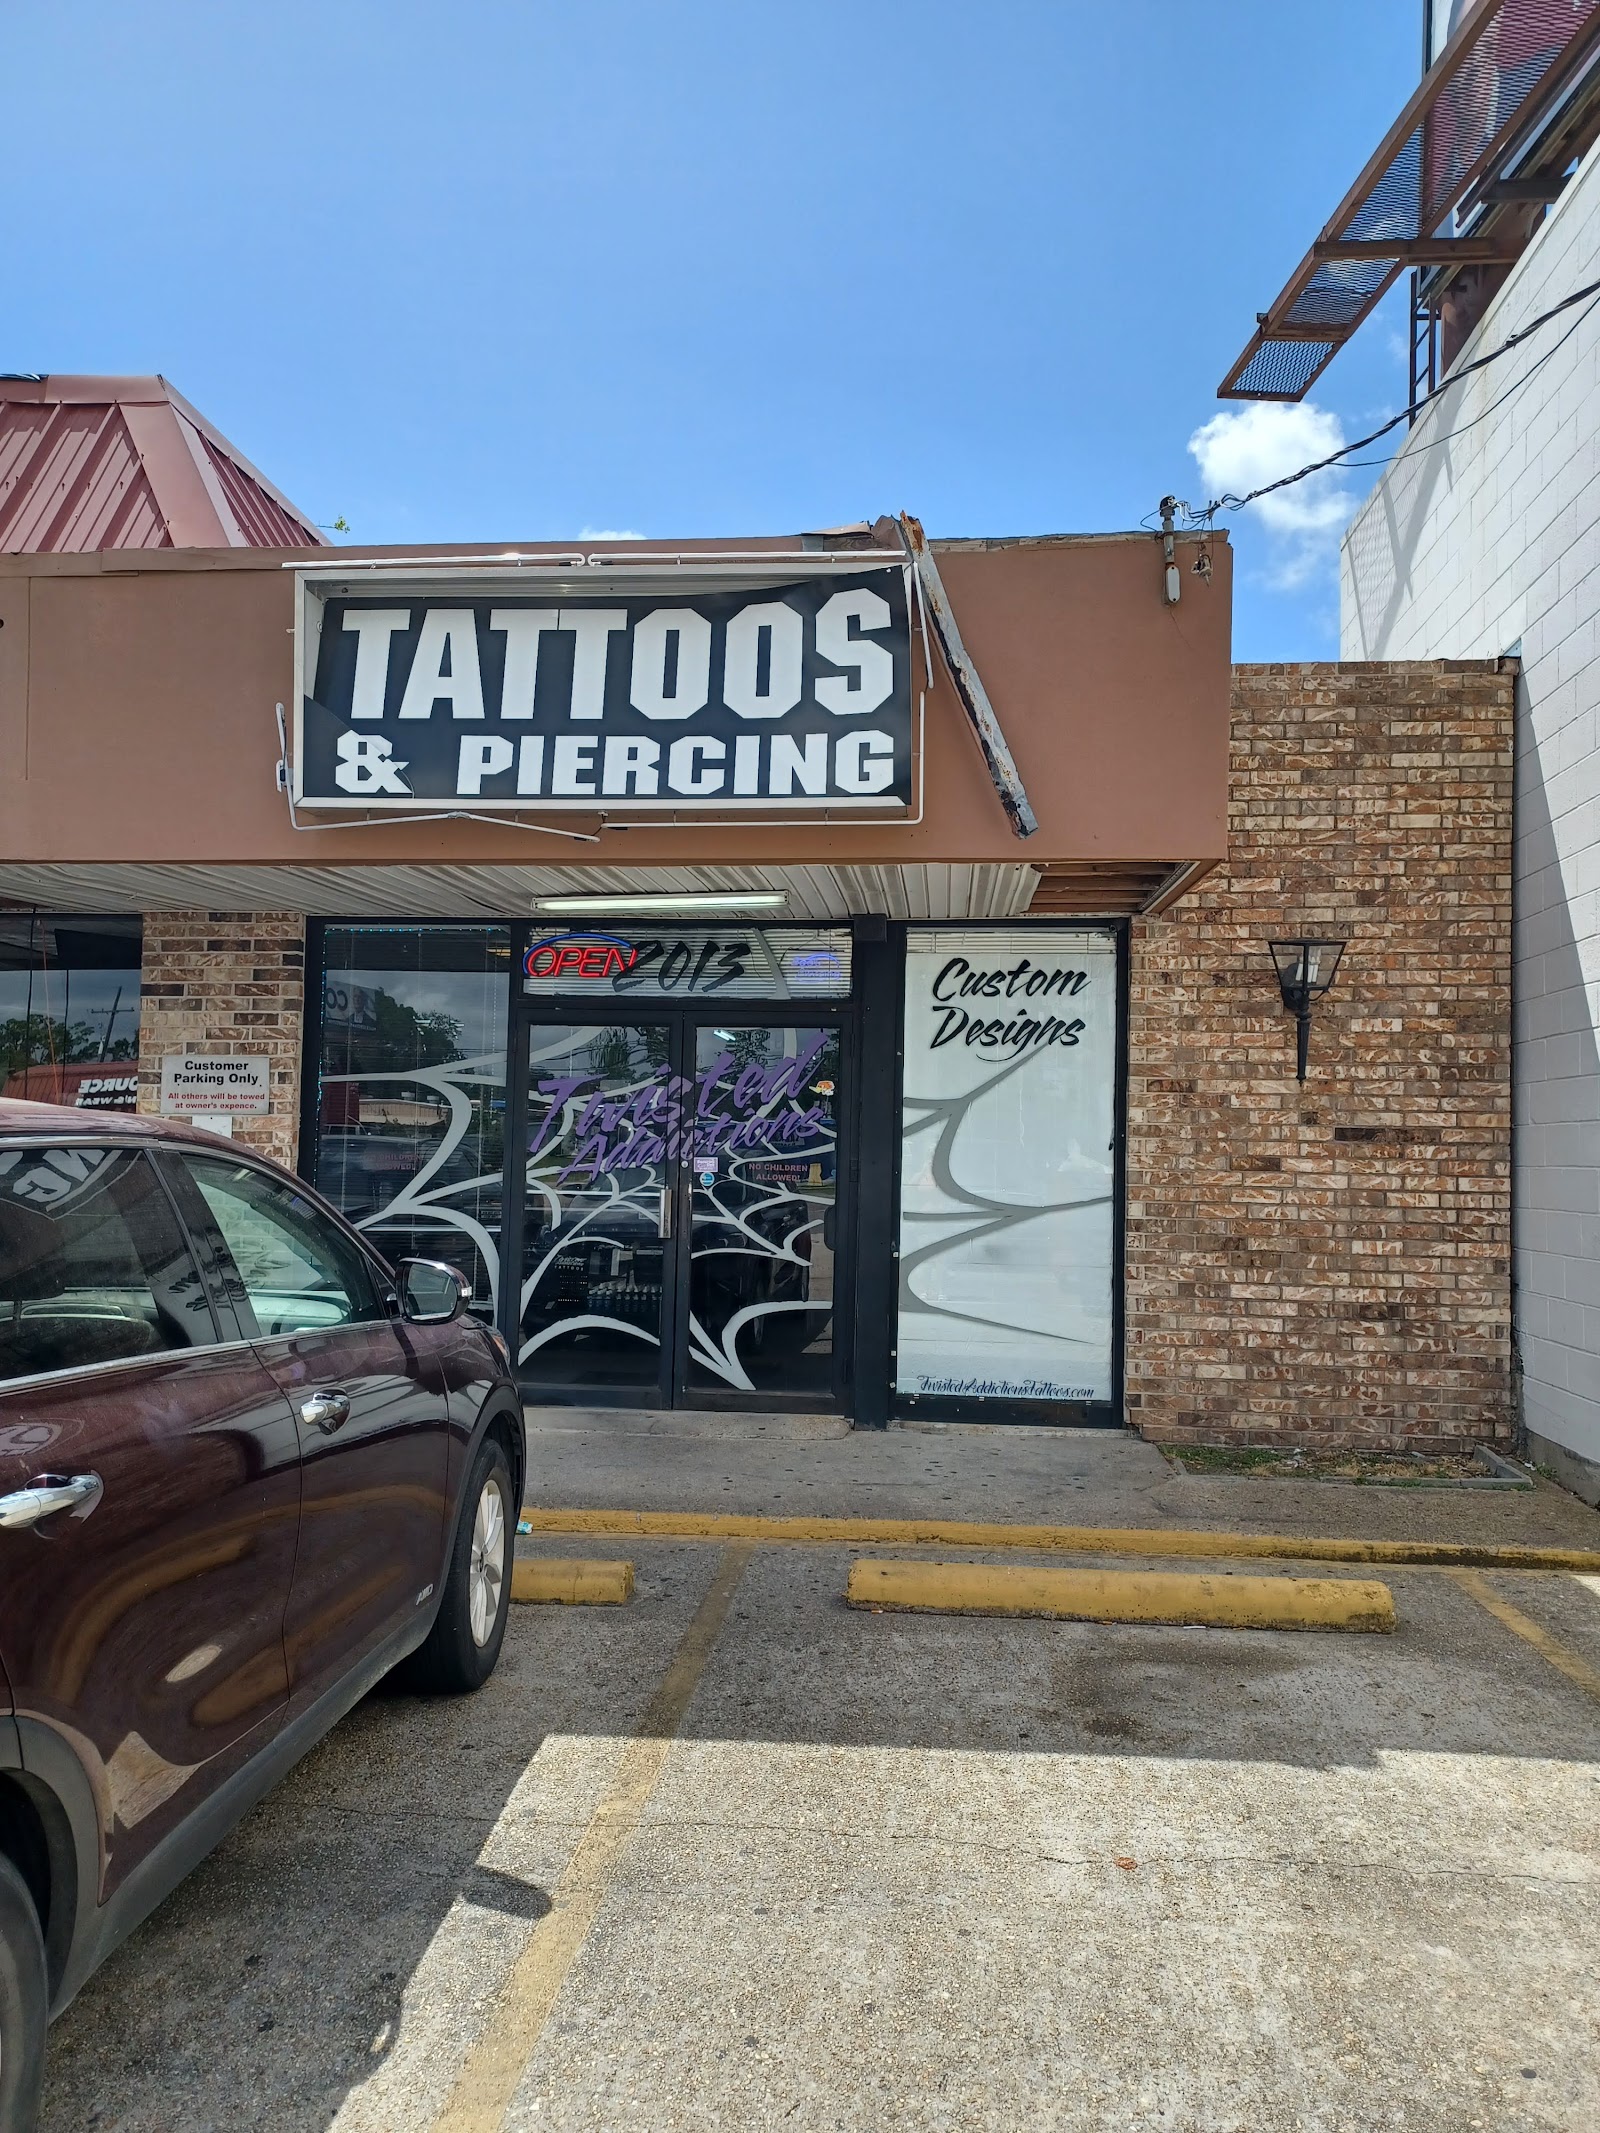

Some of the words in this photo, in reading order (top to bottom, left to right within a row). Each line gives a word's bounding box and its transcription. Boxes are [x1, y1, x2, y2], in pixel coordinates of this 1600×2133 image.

[341, 587, 894, 720] TATTOOS
[335, 729, 414, 794] &
[456, 729, 895, 796] PIERCING
[526, 946, 638, 978] OPEN
[610, 940, 752, 993] 2013
[932, 957, 1092, 1002] Custom
[930, 1005, 1087, 1062] Designs
[174, 1073, 224, 1085] Parking
[228, 1073, 259, 1085] Only
[184, 1061, 249, 1071] Customer
[219, 1102, 257, 1110] expence.
[529, 1030, 829, 1153] Twisted
[748, 1162, 761, 1170] NO
[764, 1163, 808, 1172] CHILDREN
[756, 1173, 800, 1182] ALLOWED!
[916, 1375, 1095, 1399] TwistedAddictionsTattoos.com
